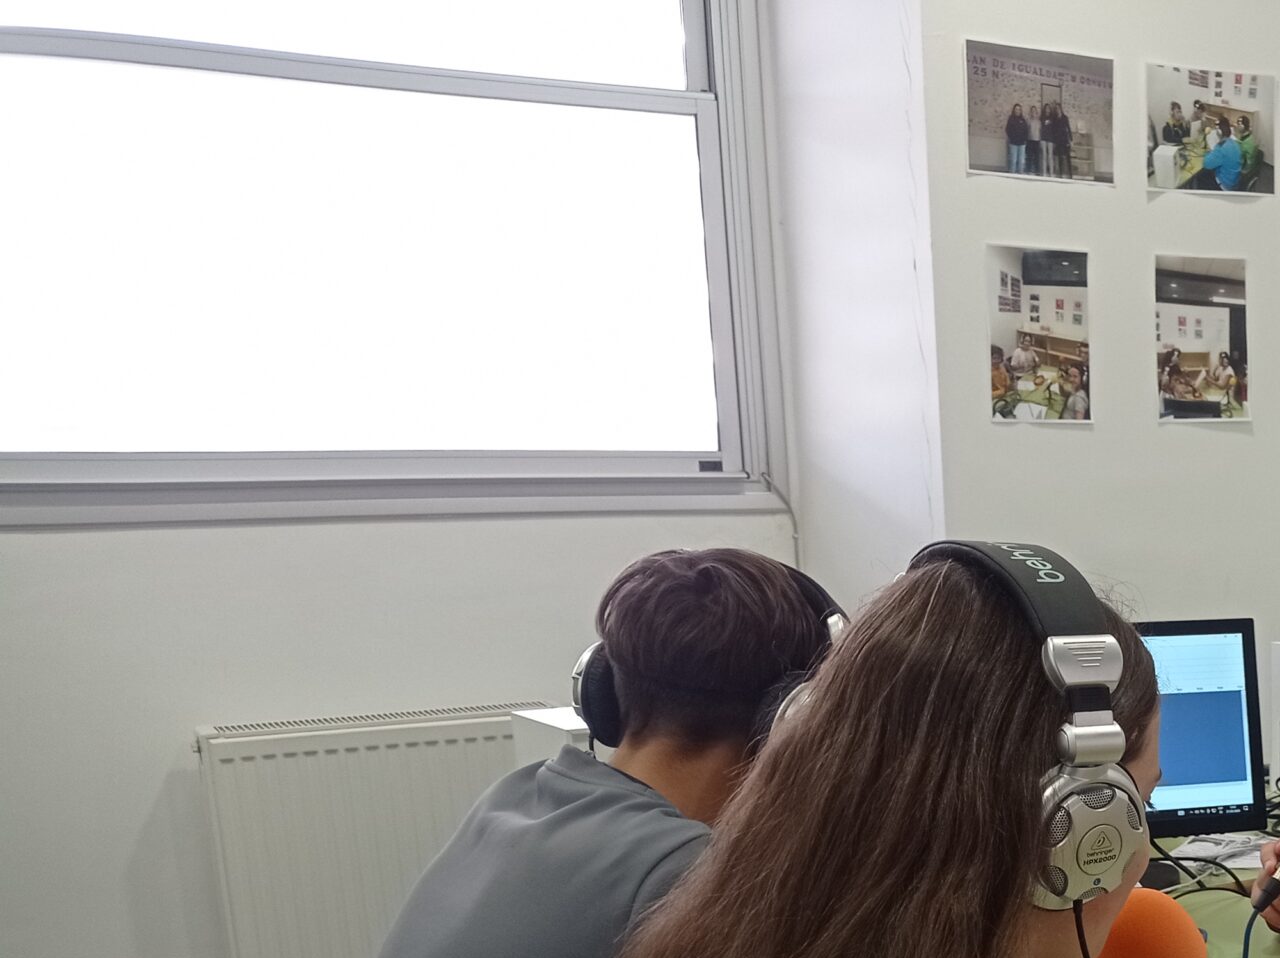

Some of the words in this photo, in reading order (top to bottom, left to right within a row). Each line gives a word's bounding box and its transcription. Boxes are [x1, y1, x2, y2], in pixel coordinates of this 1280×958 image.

[992, 58, 1006, 70] DE
[973, 66, 987, 77] 25
[1083, 854, 1117, 866] HPX2000
